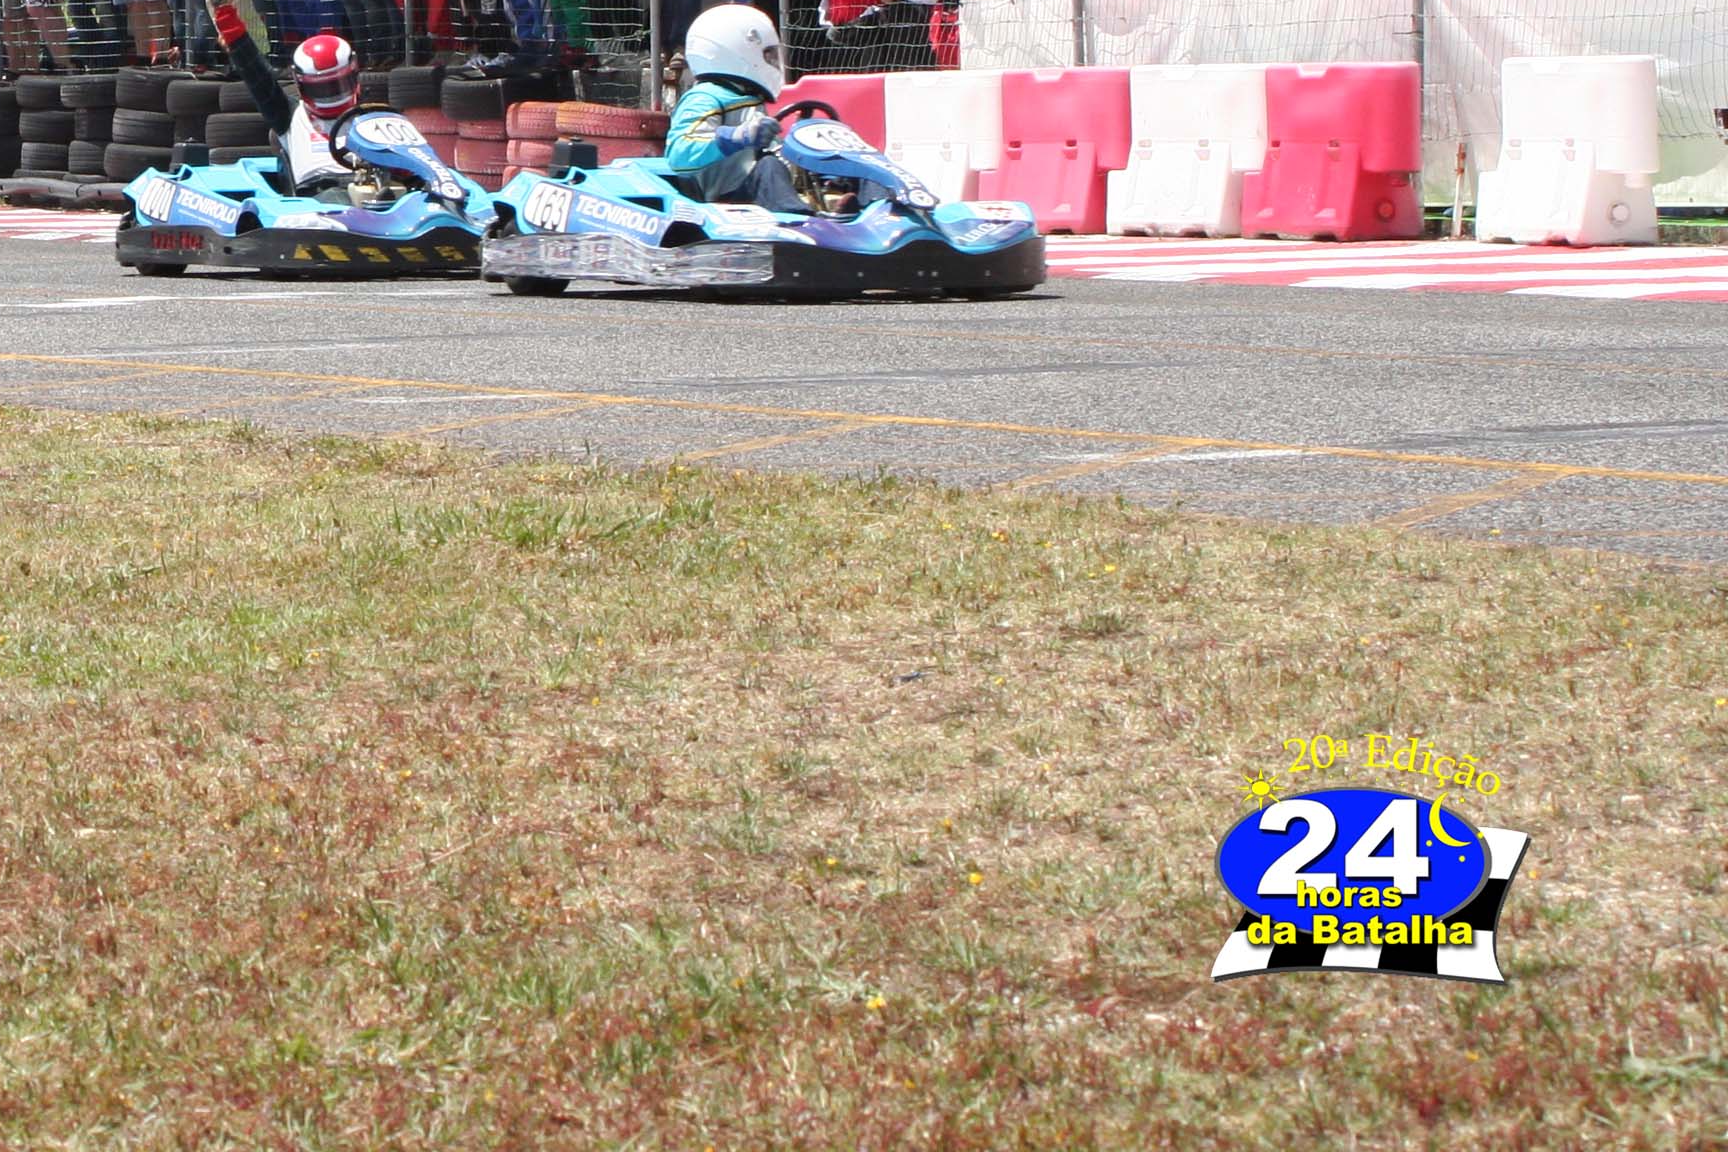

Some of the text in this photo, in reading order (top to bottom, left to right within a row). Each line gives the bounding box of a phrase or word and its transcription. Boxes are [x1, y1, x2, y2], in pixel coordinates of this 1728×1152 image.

[373, 122, 419, 143] 100
[816, 130, 869, 150] 163
[176, 187, 238, 225] TECNIROLO
[574, 193, 660, 236] TECNIROLO
